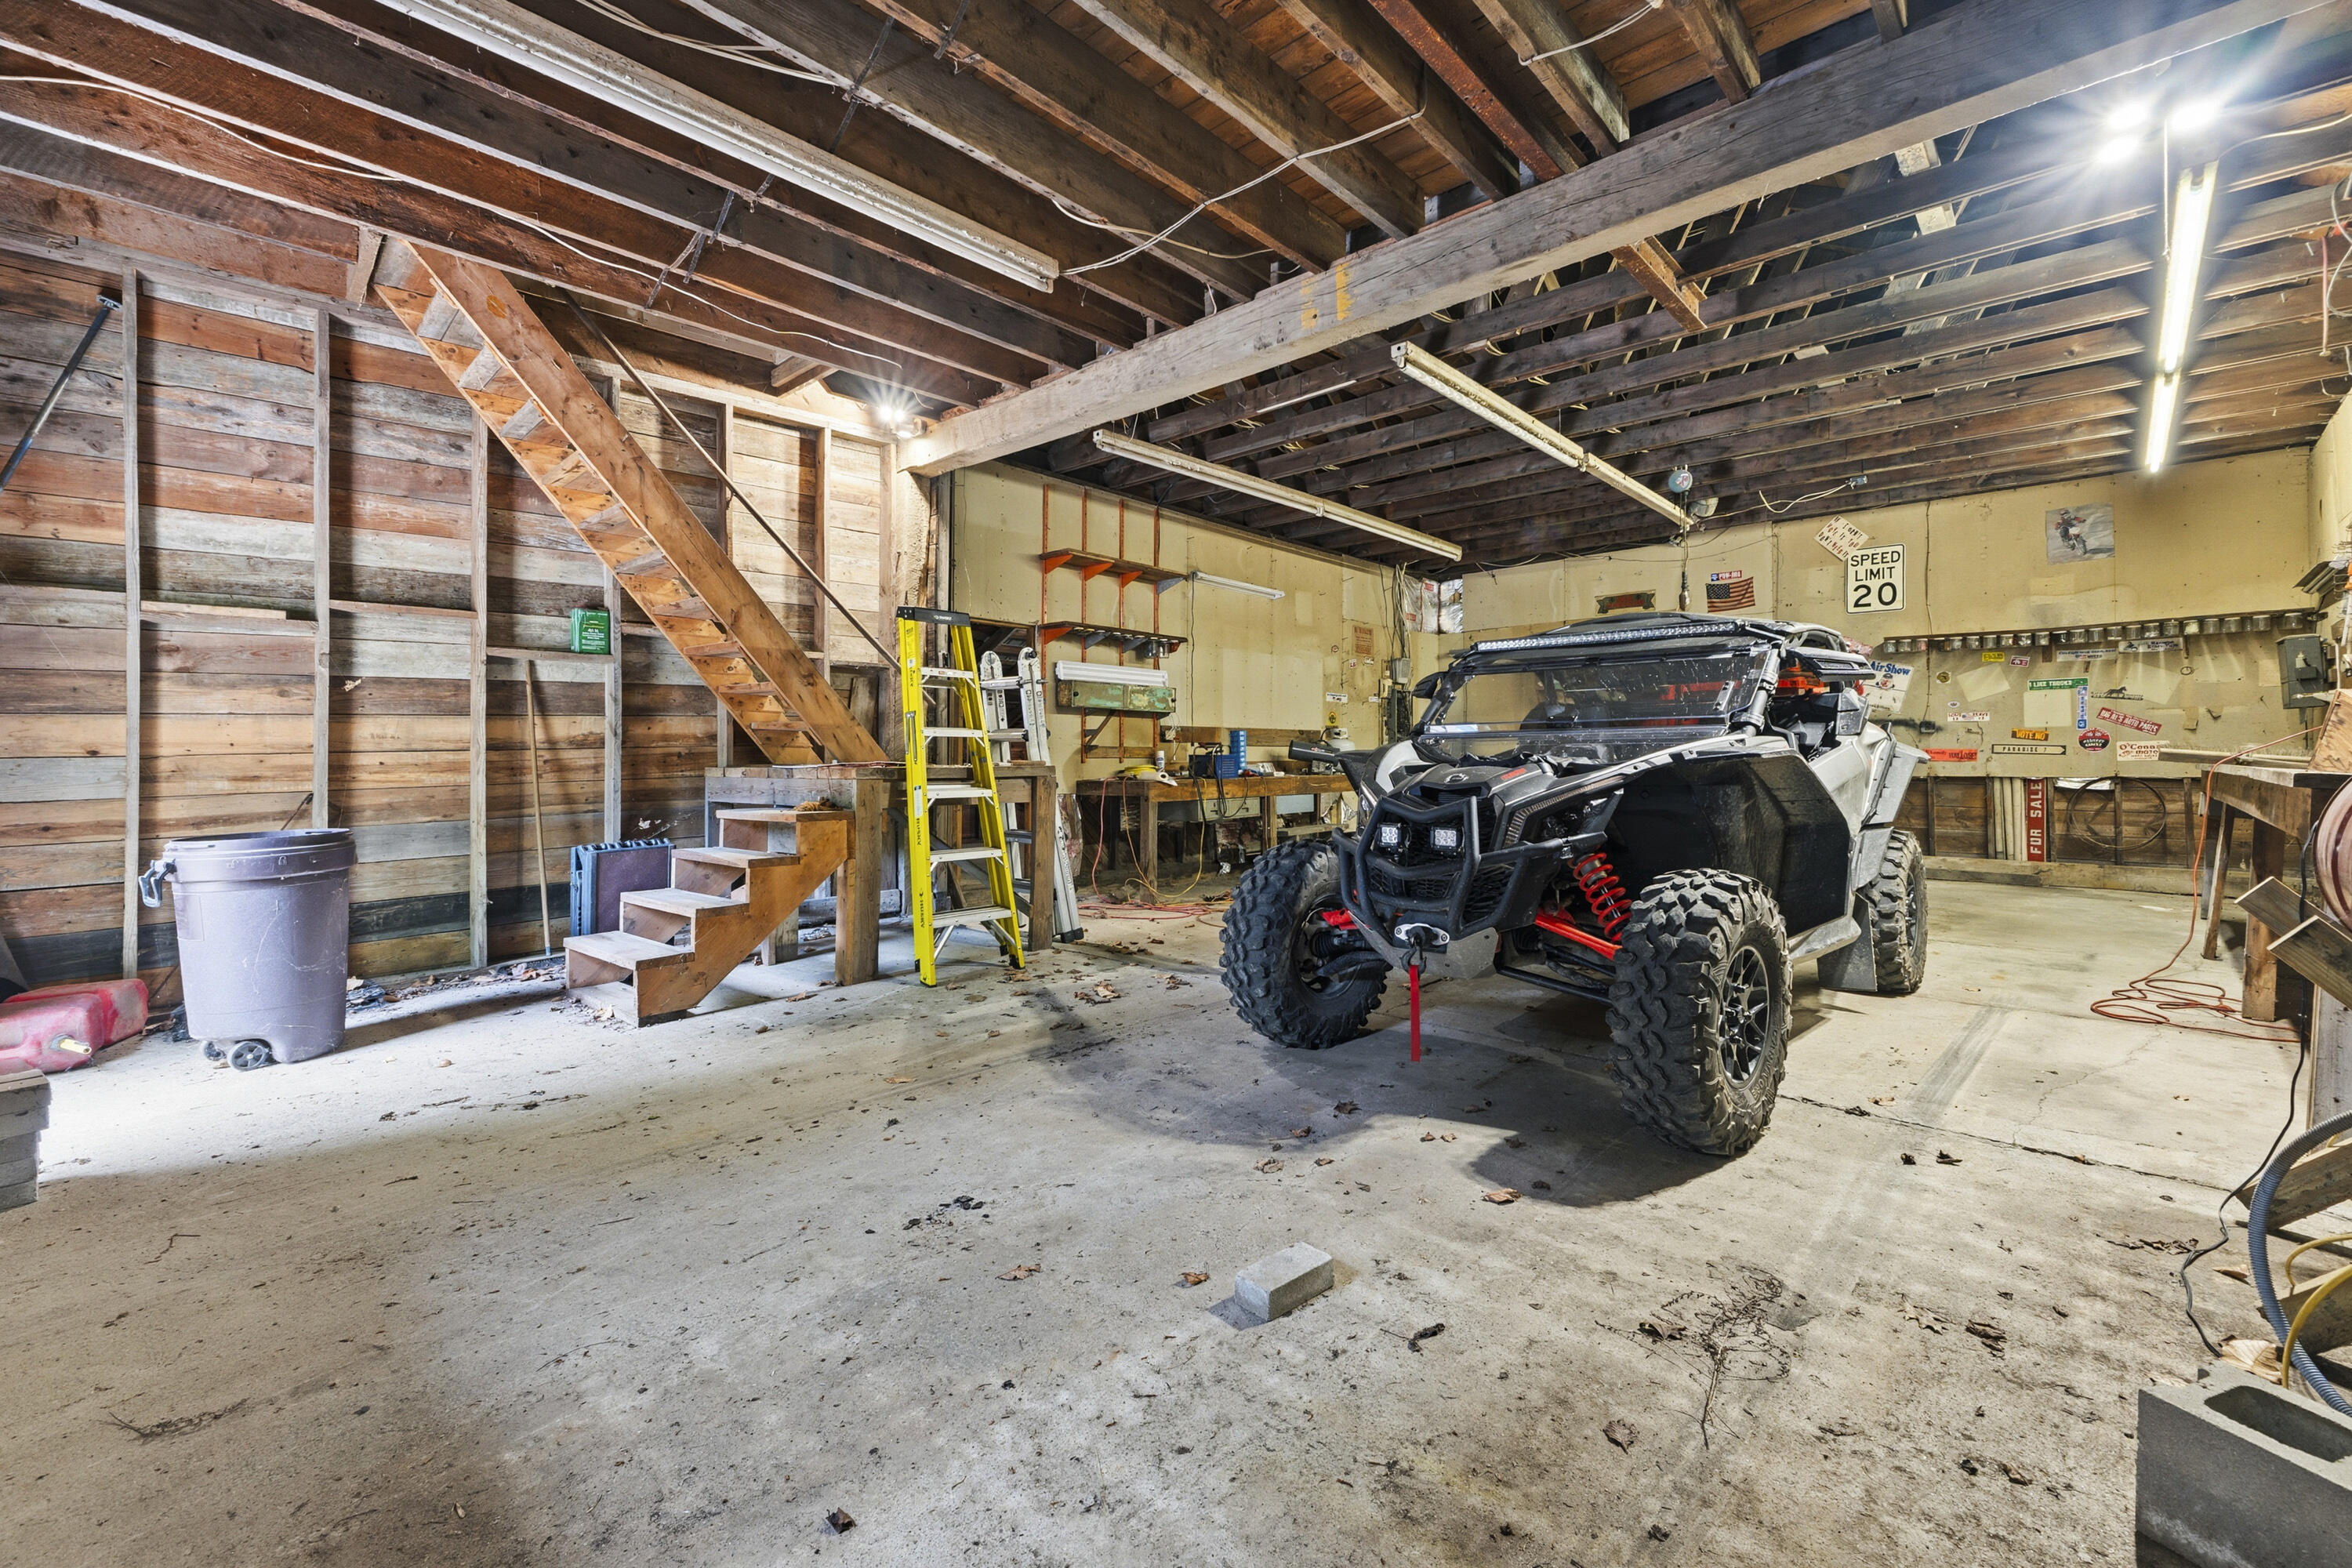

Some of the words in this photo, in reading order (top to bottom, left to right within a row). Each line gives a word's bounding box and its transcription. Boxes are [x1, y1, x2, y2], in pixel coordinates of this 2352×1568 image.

[1850, 550, 1900, 567] SPEED
[1855, 566, 1896, 582] LIMIT
[1853, 582, 1897, 608] 20
[1885, 663, 1911, 675] Show
[2123, 717, 2140, 728] AUTO
[2016, 729, 2034, 739] VOTE
[2034, 731, 2046, 740] NO
[2030, 782, 2042, 818] SALE
[2030, 829, 2042, 854] FOR
